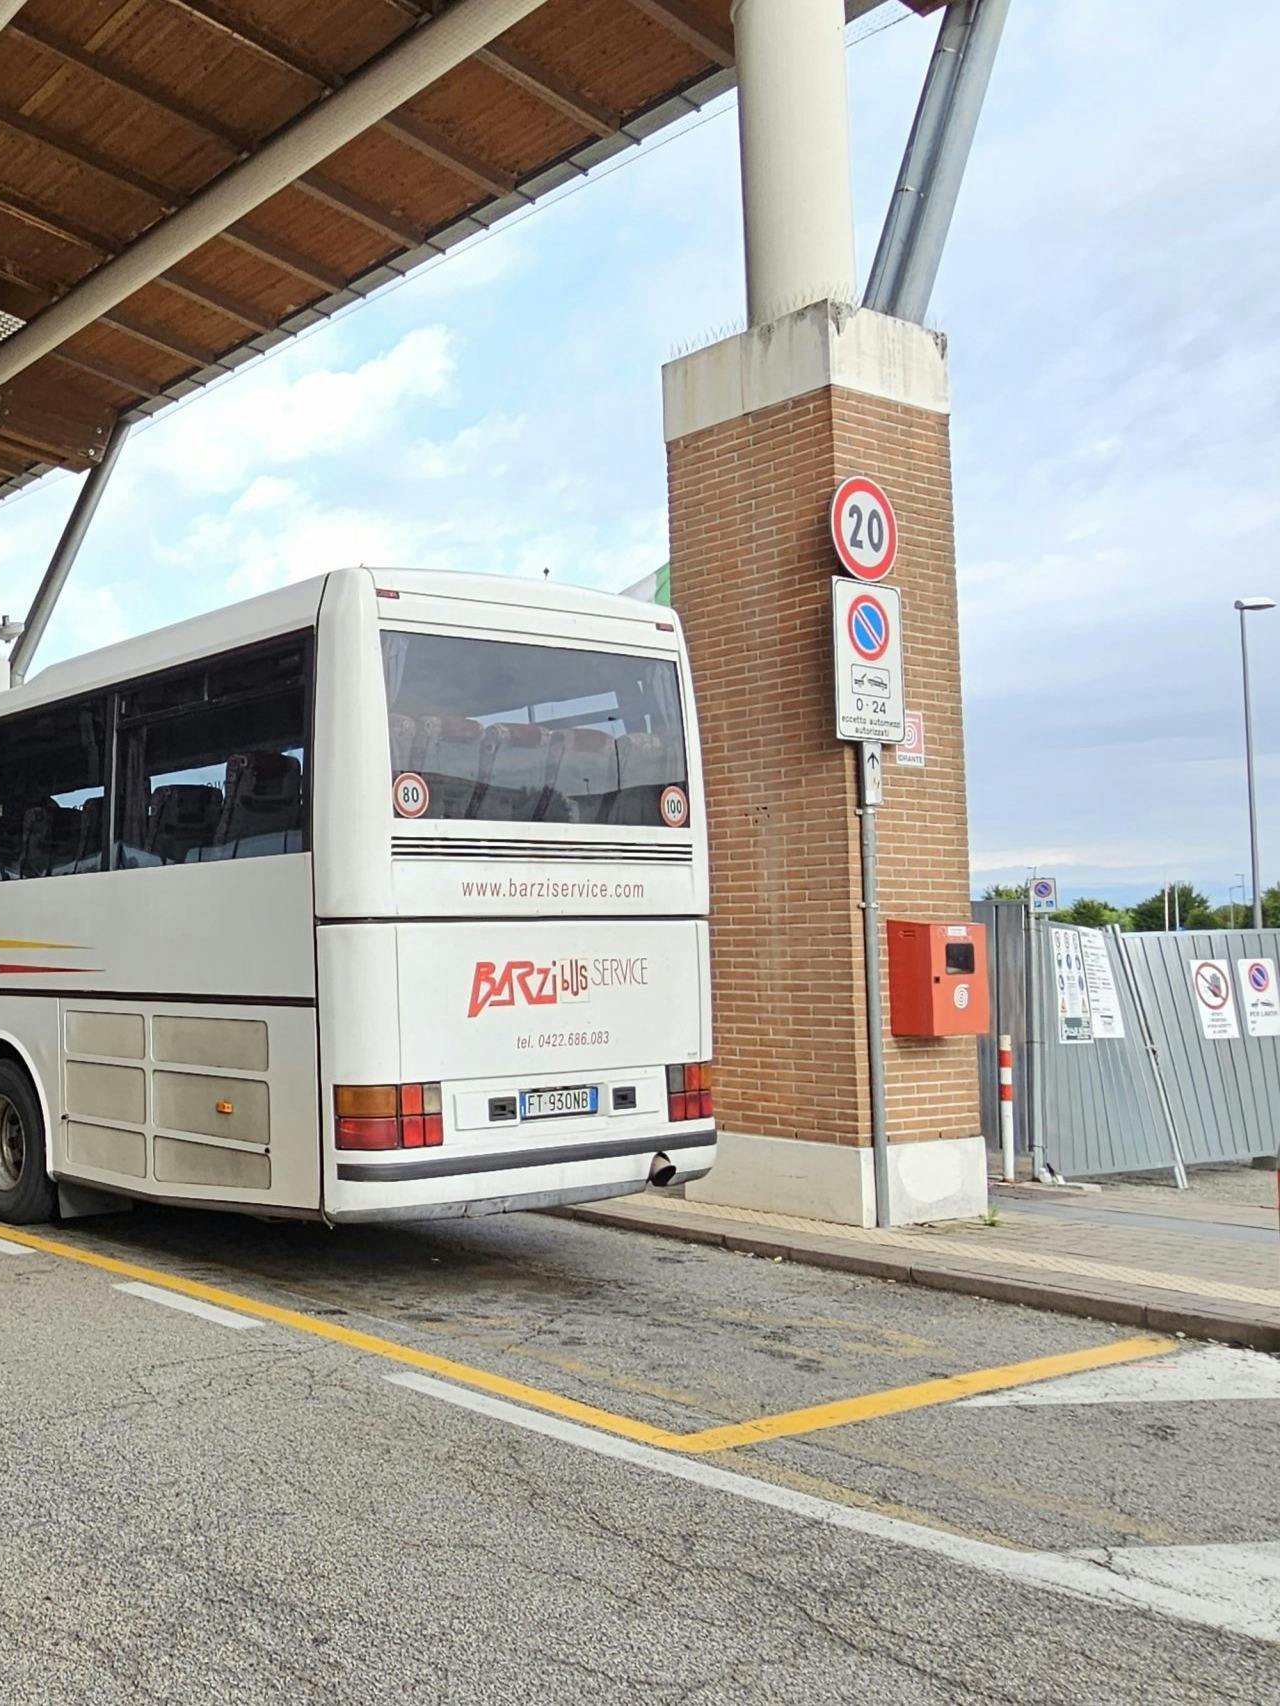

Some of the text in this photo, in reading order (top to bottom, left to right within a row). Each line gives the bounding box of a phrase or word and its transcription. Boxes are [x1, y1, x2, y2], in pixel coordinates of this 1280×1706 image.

[849, 504, 884, 552] 20
[872, 701, 886, 714] 24
[841, 715, 867, 725] eccetto
[403, 787, 419, 804] 80
[667, 798, 682, 814] 100
[462, 877, 645, 899] www.barziservice.com
[591, 957, 648, 986] SERVICE
[517, 1031, 610, 1050] tel. 0422.686.083
